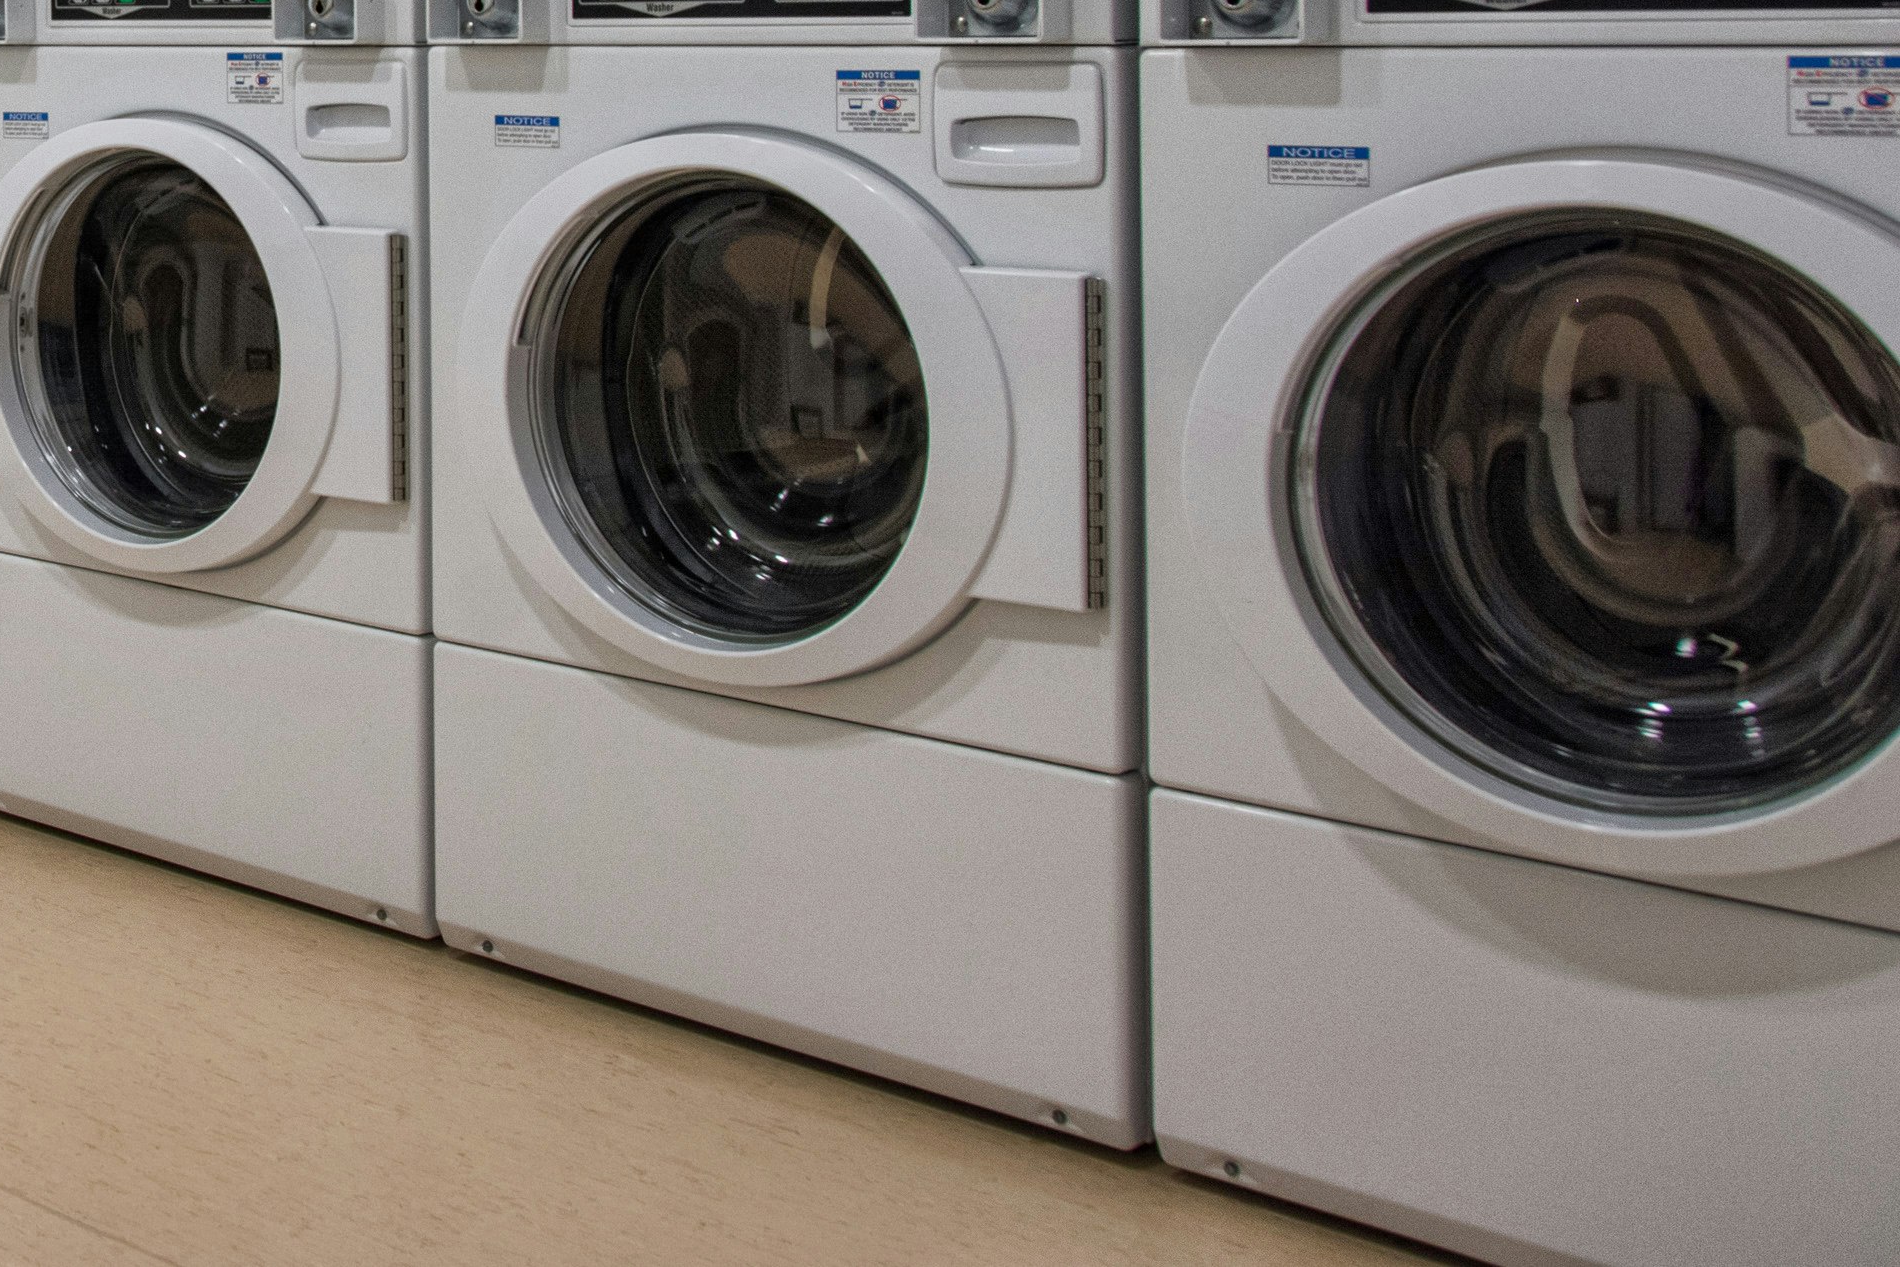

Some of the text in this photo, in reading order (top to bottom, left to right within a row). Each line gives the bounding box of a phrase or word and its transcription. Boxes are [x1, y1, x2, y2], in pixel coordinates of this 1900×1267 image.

[646, 3, 674, 12] Washer
[1830, 58, 1884, 67] NOTICE
[504, 117, 551, 125] NOTICE
[1282, 148, 1356, 158] NOTICE
